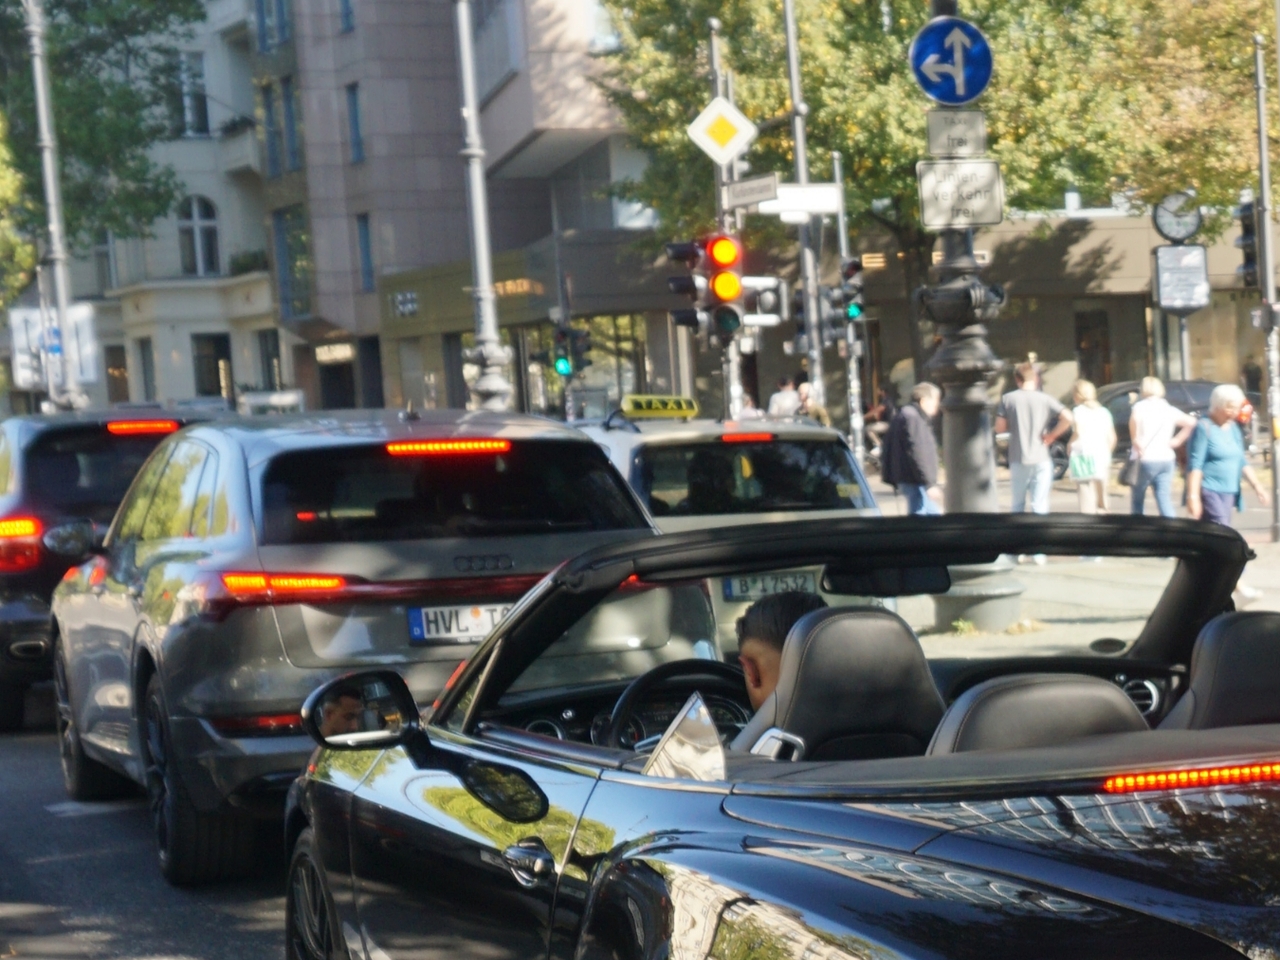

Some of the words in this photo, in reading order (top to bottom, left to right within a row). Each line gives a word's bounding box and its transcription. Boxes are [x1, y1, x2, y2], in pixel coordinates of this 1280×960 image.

[947, 134, 968, 147] frei
[935, 171, 986, 183] Linien-
[951, 206, 976, 218] frei
[634, 398, 687, 410] TAXI
[740, 578, 750, 594] B
[424, 609, 469, 635] HVL
